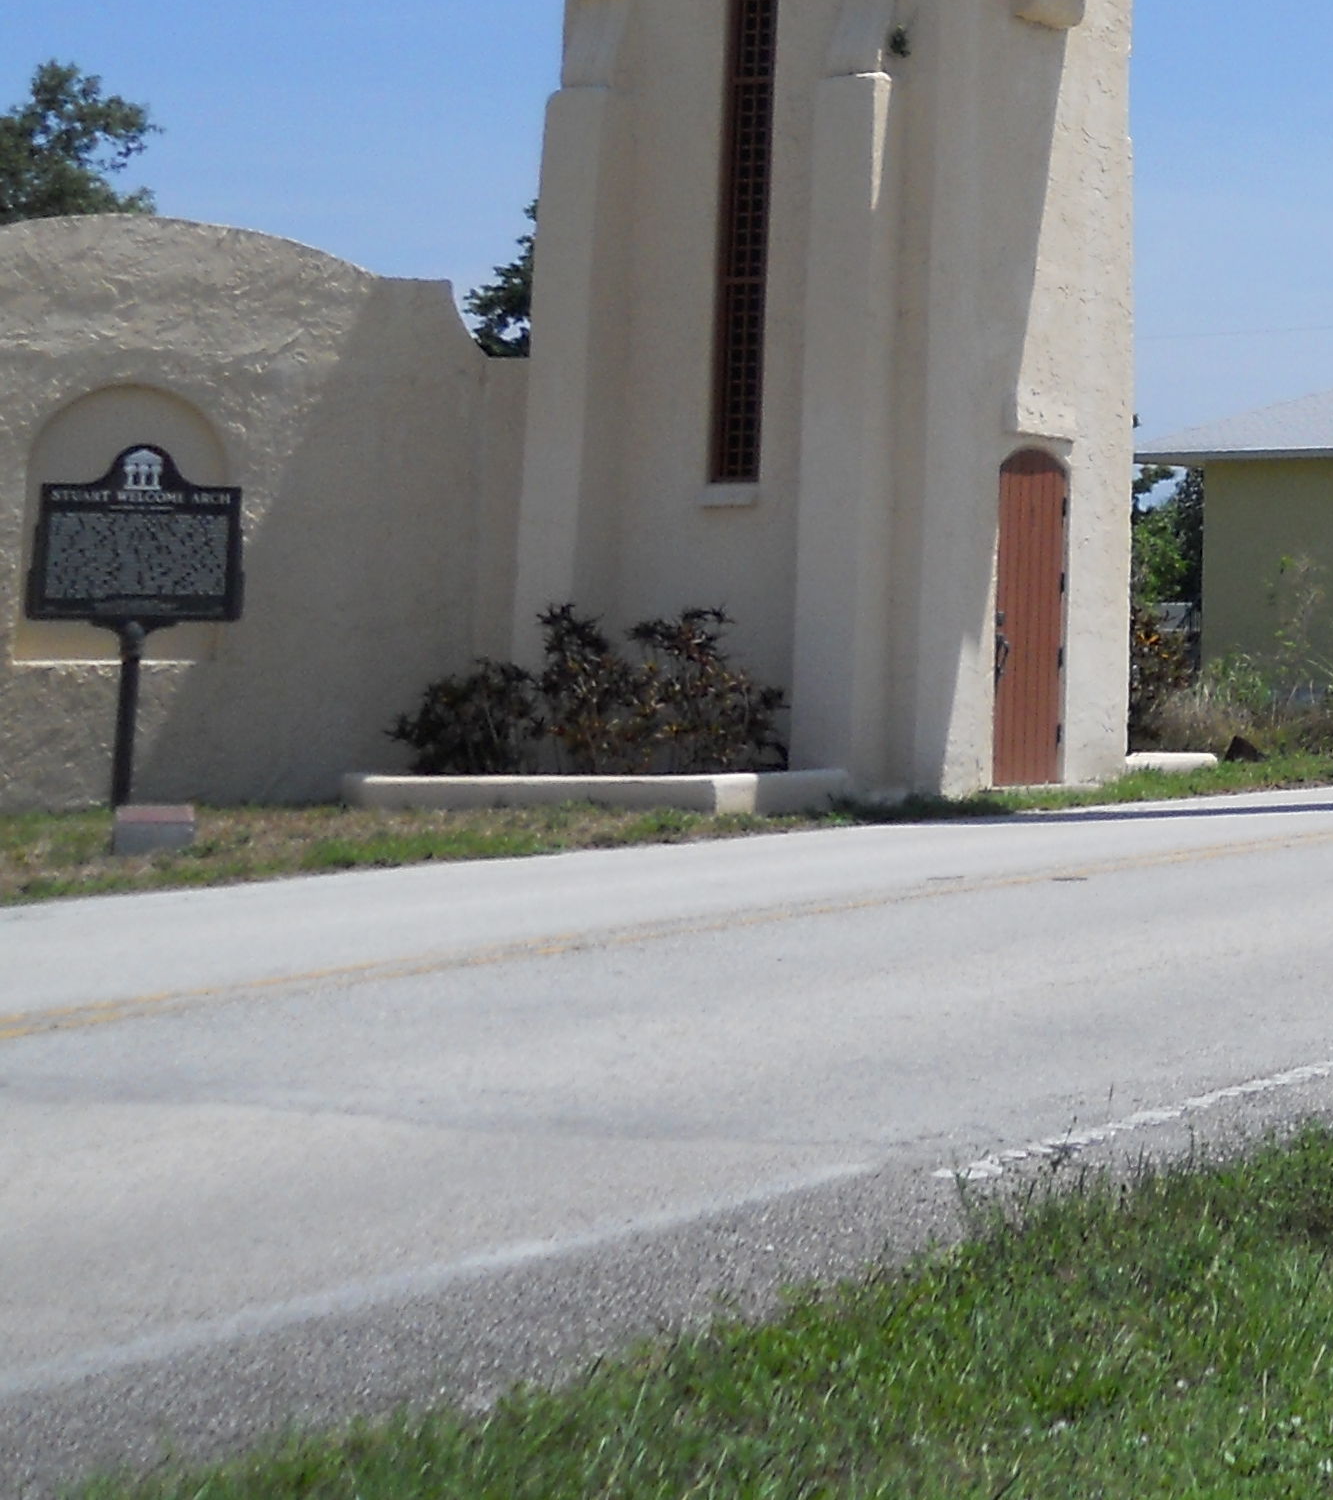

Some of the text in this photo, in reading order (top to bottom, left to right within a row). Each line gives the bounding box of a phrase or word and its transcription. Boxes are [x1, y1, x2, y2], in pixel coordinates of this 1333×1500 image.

[51, 489, 231, 504] STUART WELCOME ARCH
